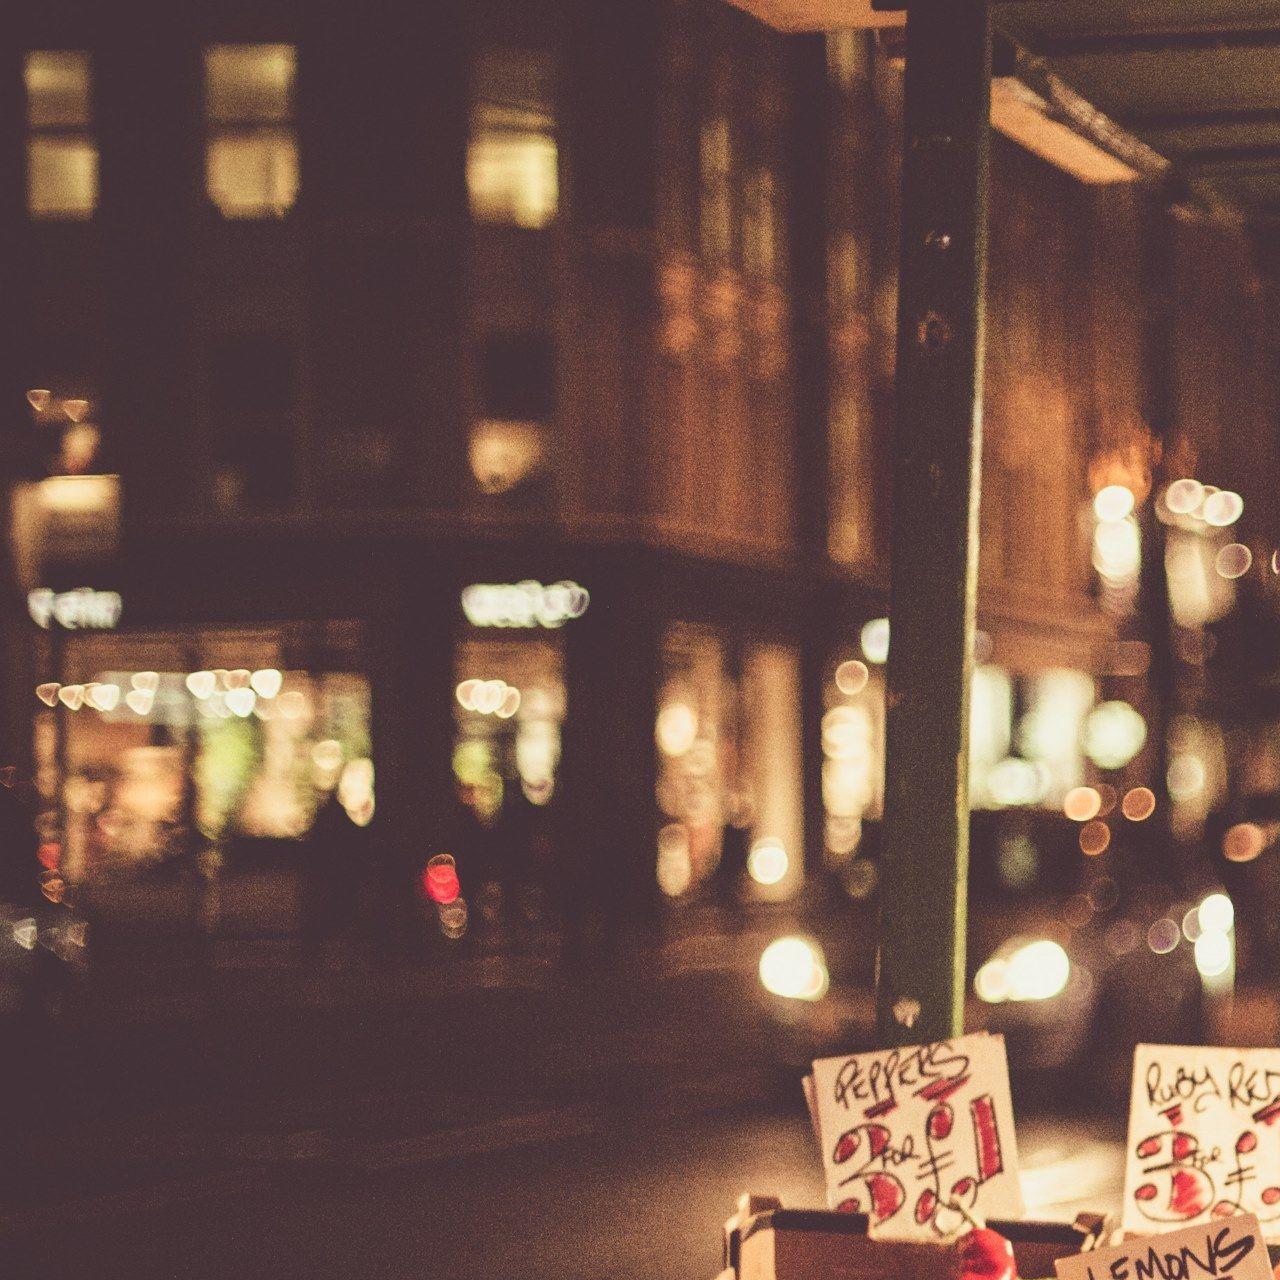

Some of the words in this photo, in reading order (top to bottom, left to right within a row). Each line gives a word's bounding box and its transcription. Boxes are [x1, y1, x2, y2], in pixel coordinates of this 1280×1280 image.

[834, 1041, 970, 1108] PEPPERS
[833, 1123, 906, 1229] 3
[1135, 1130, 1215, 1222] 3
